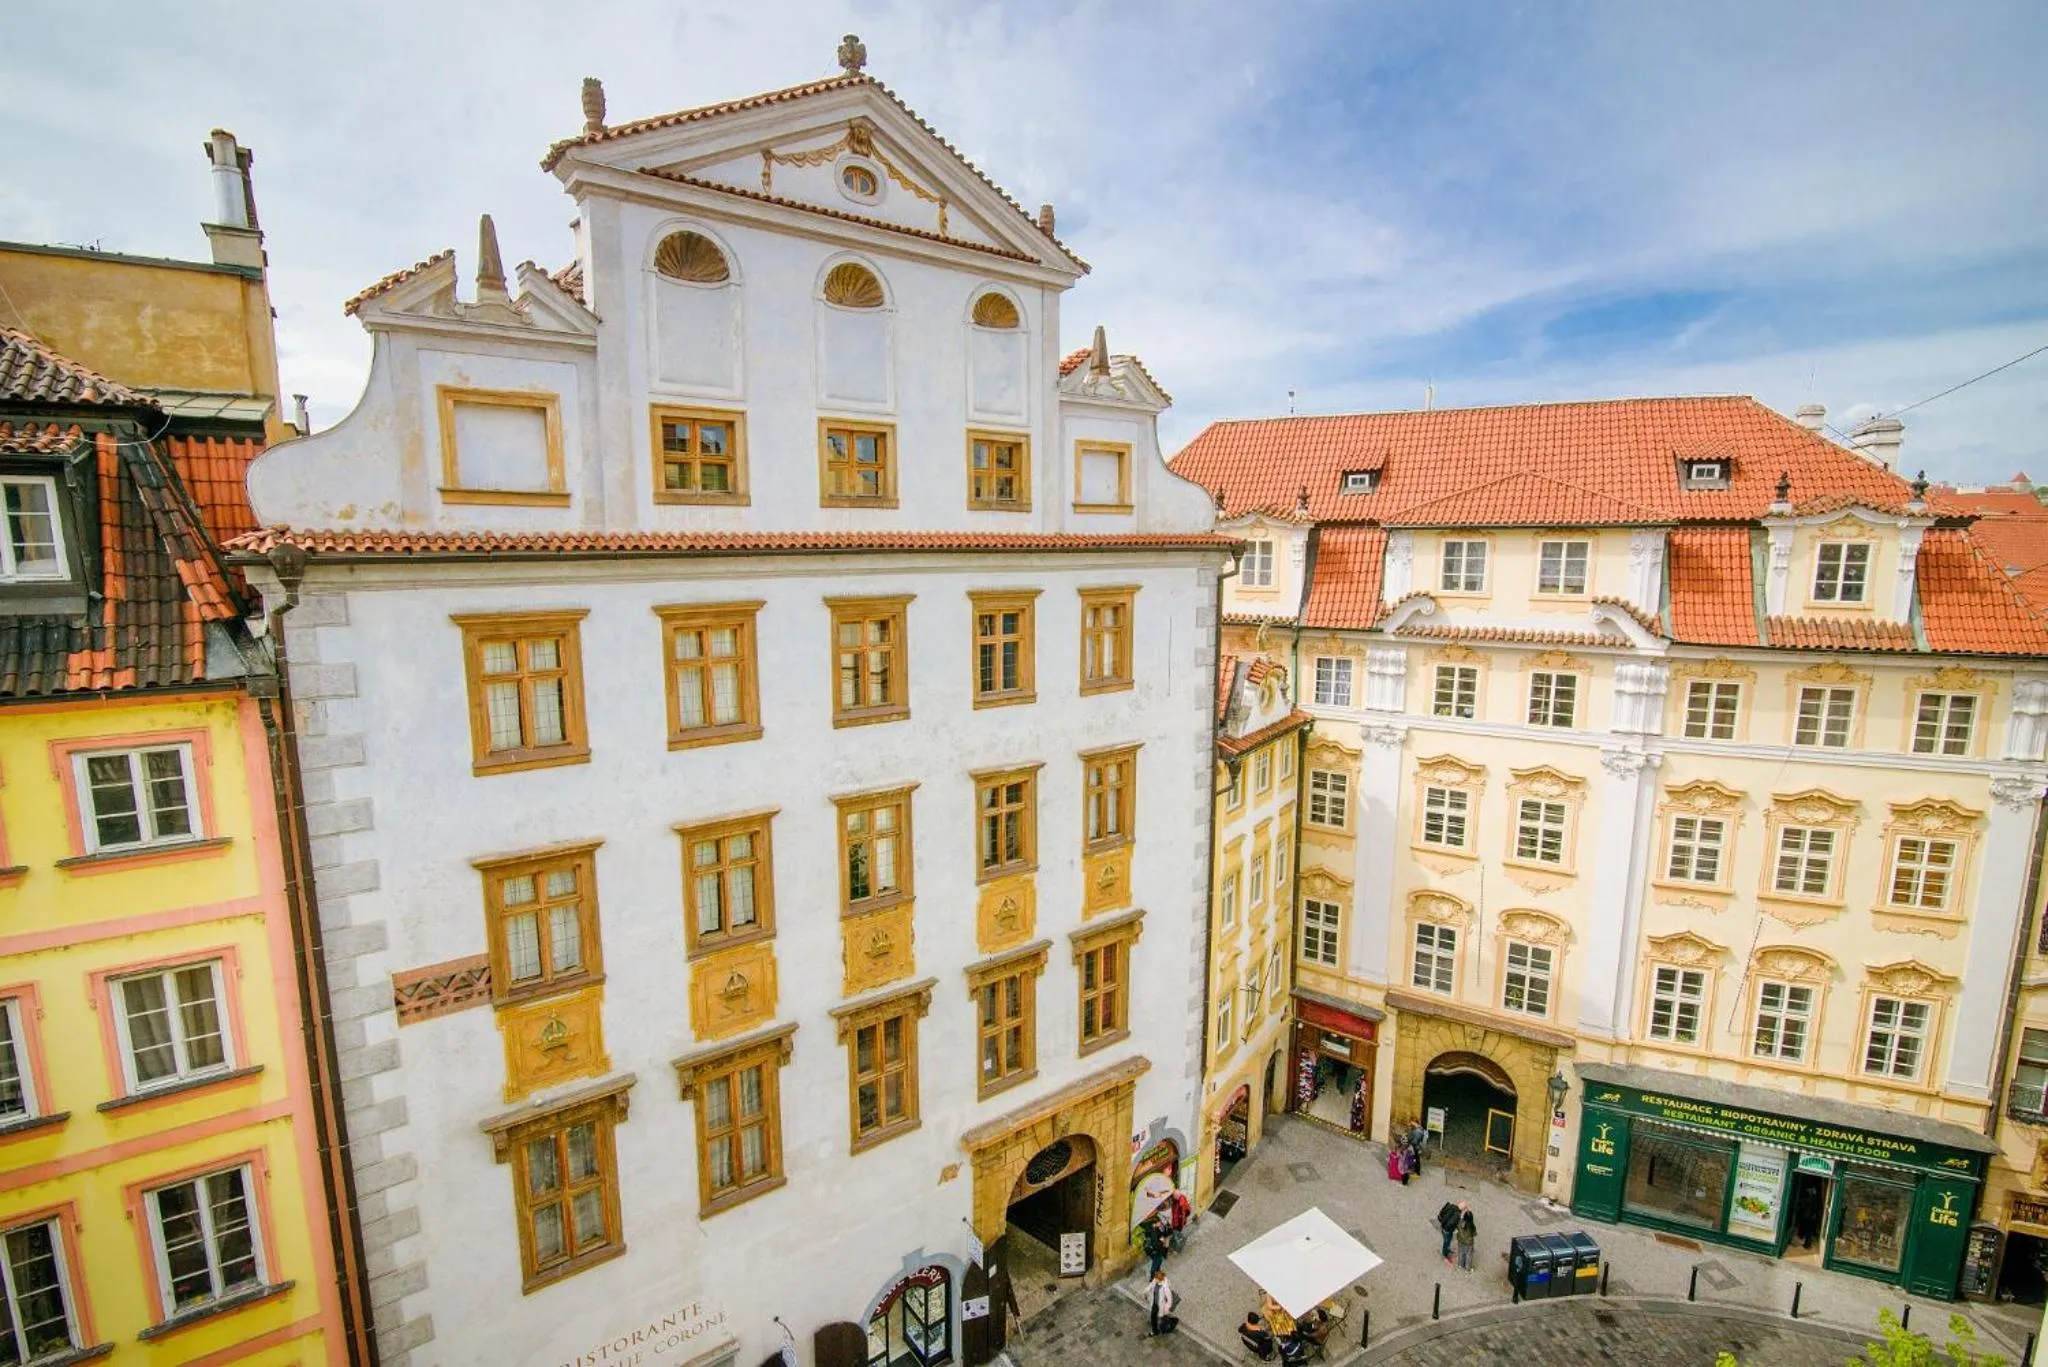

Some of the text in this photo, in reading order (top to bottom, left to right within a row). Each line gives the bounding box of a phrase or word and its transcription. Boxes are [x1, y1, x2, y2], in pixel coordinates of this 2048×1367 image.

[1641, 1094, 1713, 1114] RESTAURACE
[1720, 1109, 1808, 1132] BIOPOTRAVINY
[1815, 1127, 1865, 1144] ZDRAVÁ
[1867, 1136, 1917, 1153] STRAVA
[1663, 1108, 1737, 1129] RESTAURANT
[1743, 1124, 1797, 1141] ORGANIC
[1809, 1137, 1855, 1152] HEALTH
[1857, 1145, 1891, 1158] FOOD
[1930, 1210, 1958, 1228] Life
